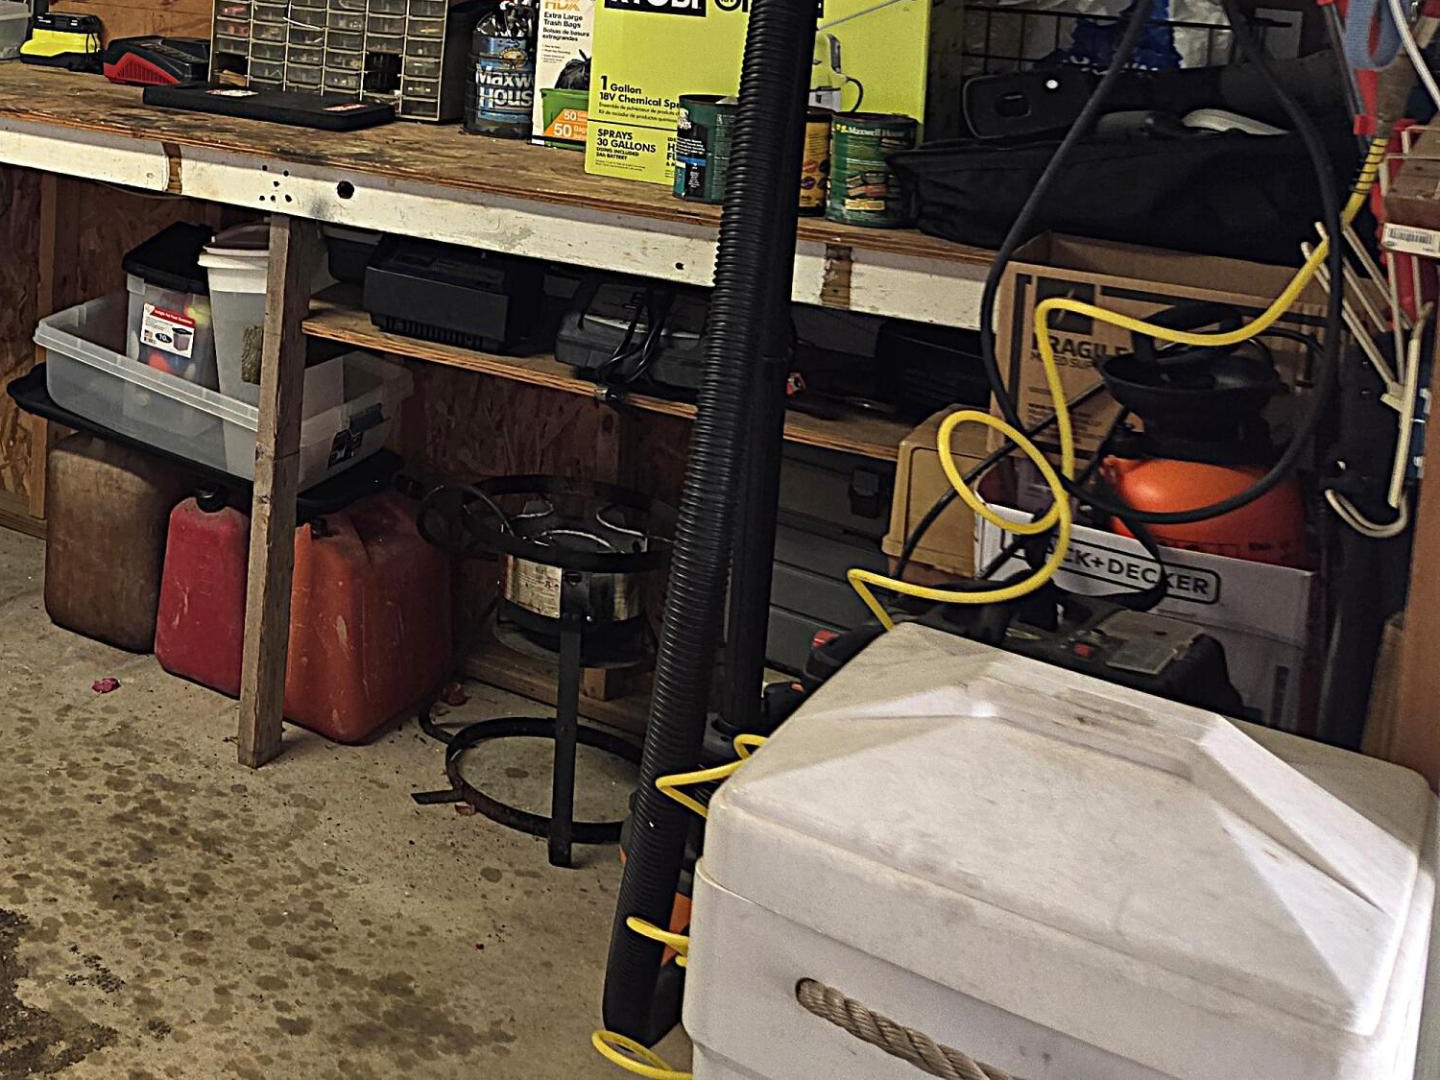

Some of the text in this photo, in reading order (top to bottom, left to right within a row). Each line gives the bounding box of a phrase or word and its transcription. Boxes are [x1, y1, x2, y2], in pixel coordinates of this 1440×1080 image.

[543, 11, 583, 22] Extra Large
[543, 19, 581, 29] Trash Bags
[600, 75, 642, 95] 1 Gallon
[599, 91, 616, 102] 18V
[618, 95, 661, 107] Chemical
[564, 110, 577, 121] 50
[554, 123, 573, 137] 50
[597, 128, 633, 141] SPRAYS
[596, 138, 609, 148] 30
[610, 139, 657, 153] GALLONS
